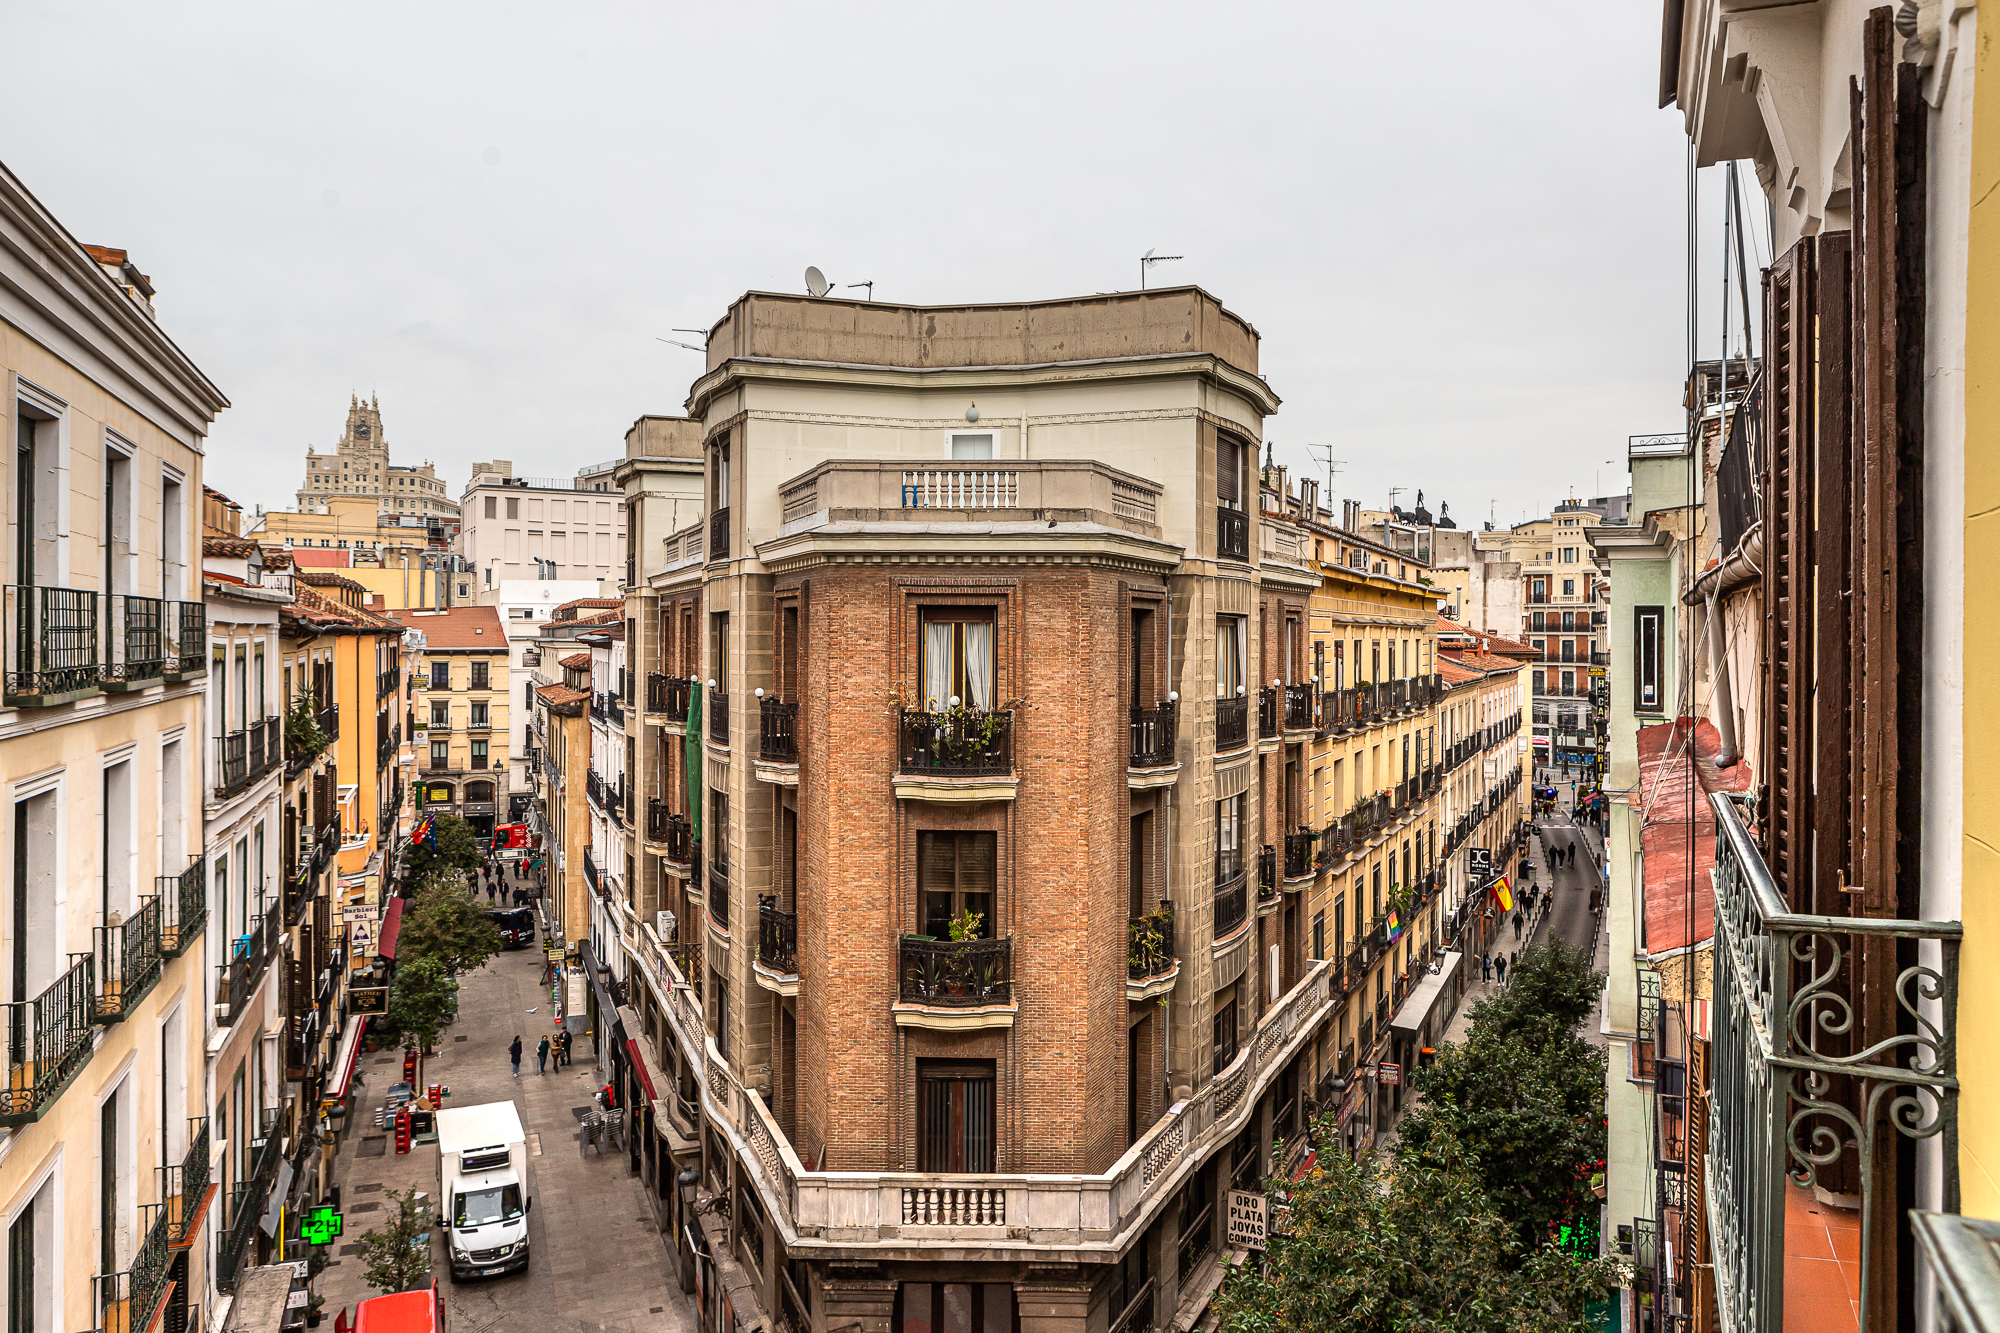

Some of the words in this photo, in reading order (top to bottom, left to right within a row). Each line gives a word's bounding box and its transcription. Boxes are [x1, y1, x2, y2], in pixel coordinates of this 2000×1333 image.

[344, 906, 378, 914] Barbieri
[1236, 1195, 1258, 1209] ORO
[1230, 1207, 1264, 1224] PLATA
[1230, 1220, 1264, 1236] JOYAS
[1229, 1232, 1265, 1247] COMPRO
